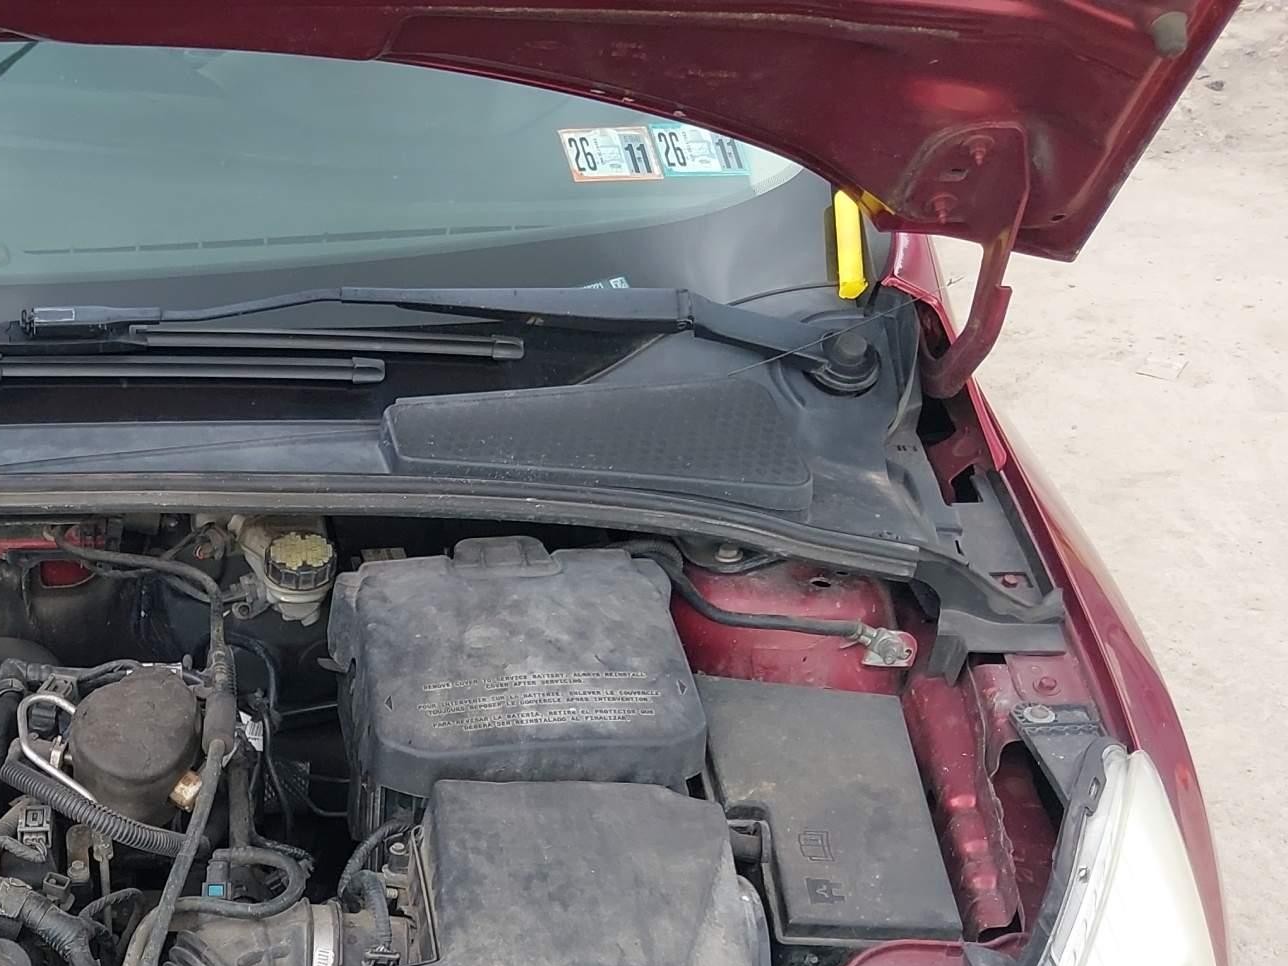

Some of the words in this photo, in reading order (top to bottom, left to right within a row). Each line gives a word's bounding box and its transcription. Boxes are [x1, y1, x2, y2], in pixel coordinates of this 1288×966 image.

[568, 137, 597, 172] 26
[624, 143, 653, 173] 11
[658, 132, 687, 167] 26
[716, 138, 743, 169] 11
[422, 682, 452, 691] REMOVE
